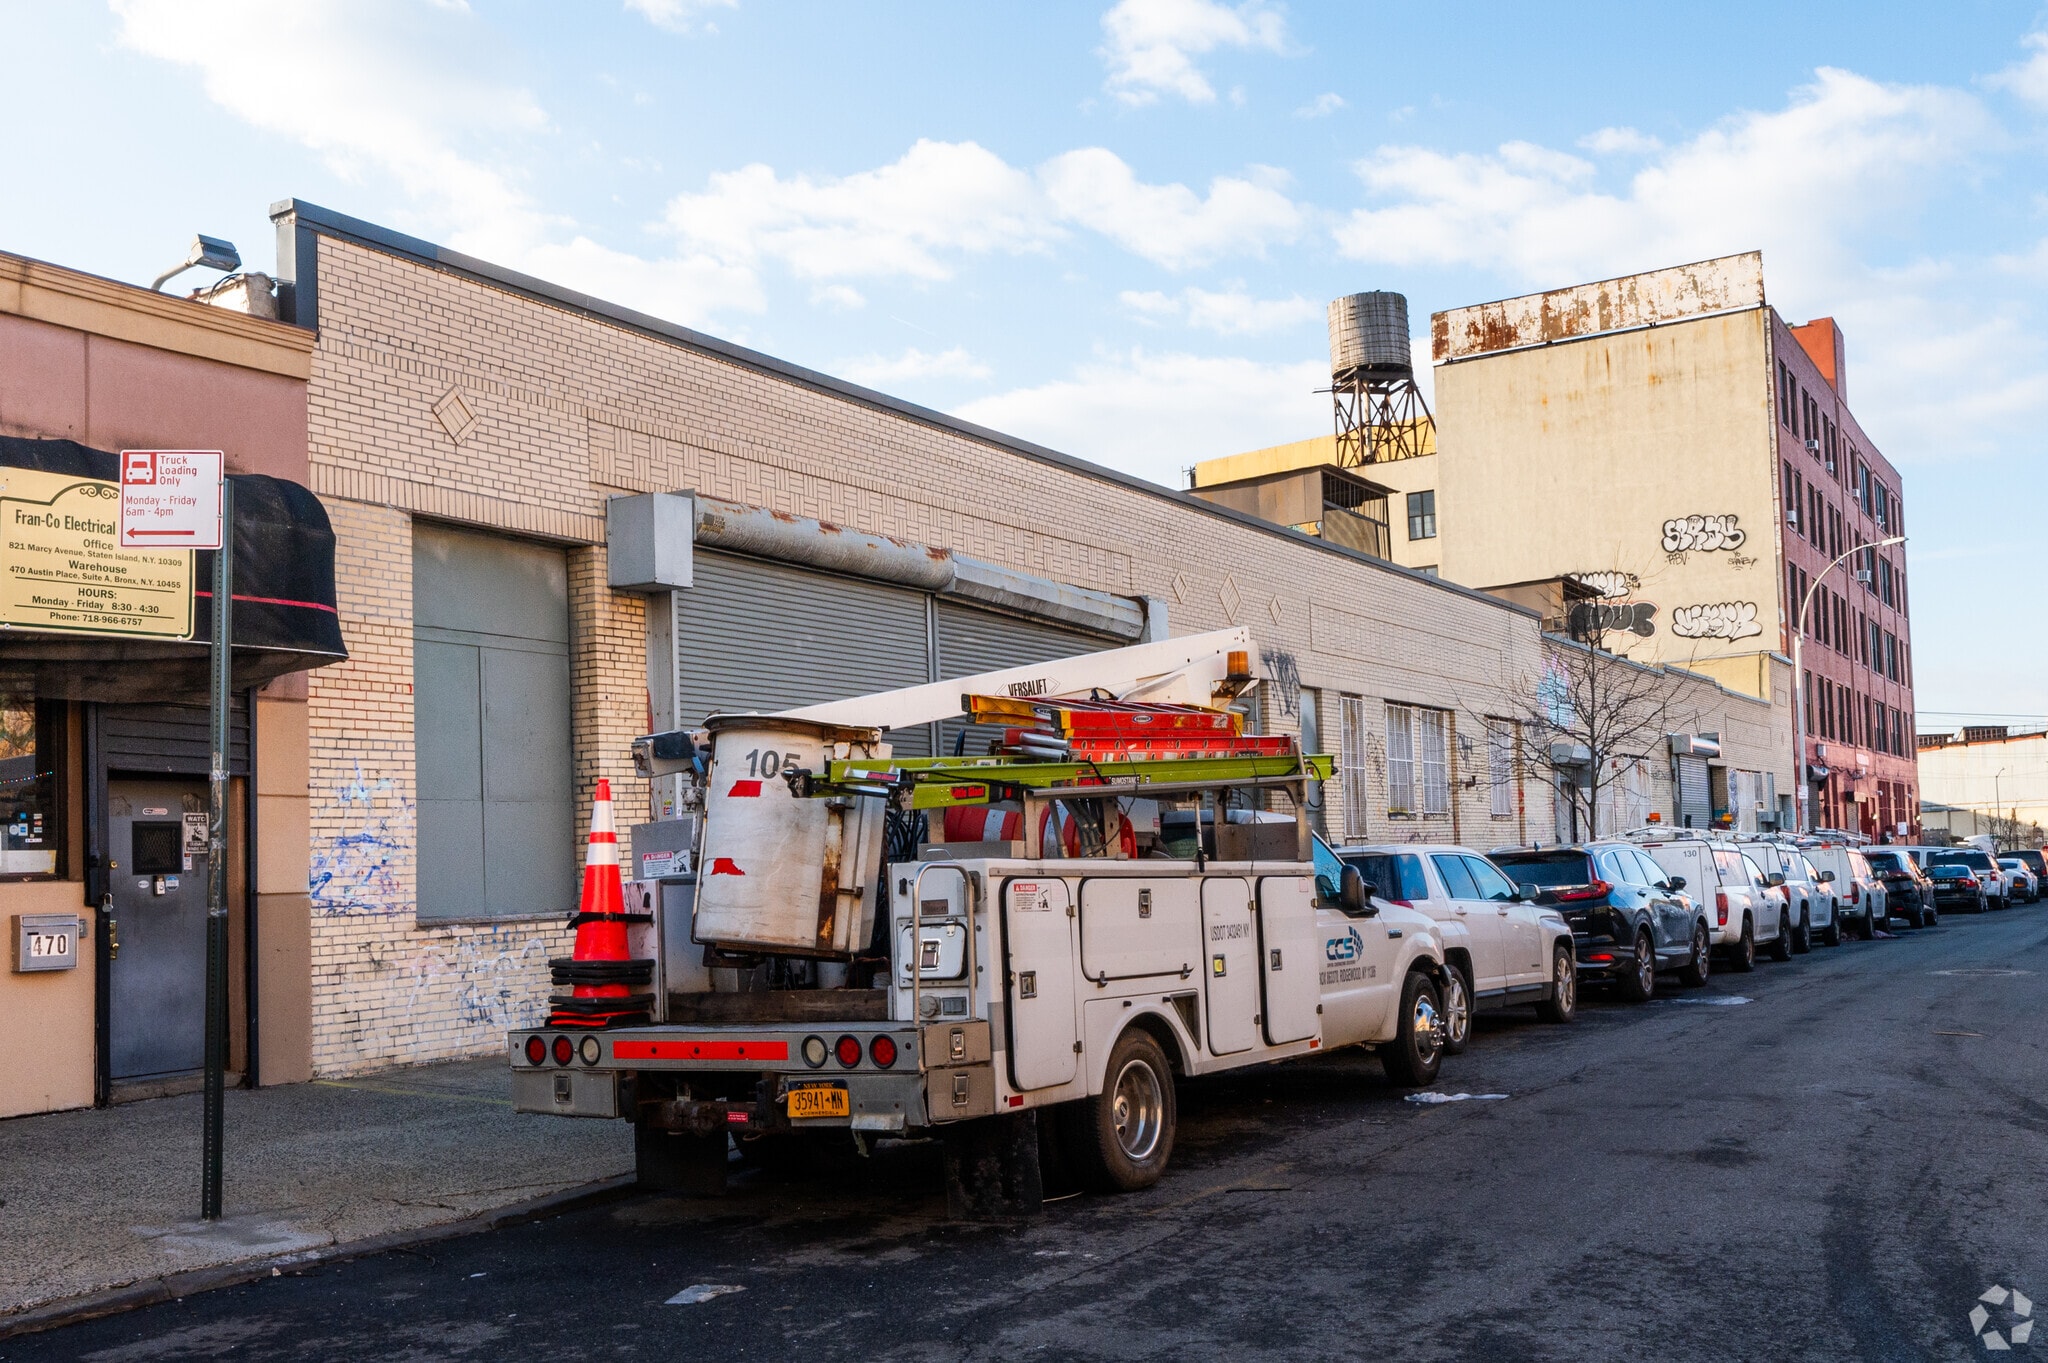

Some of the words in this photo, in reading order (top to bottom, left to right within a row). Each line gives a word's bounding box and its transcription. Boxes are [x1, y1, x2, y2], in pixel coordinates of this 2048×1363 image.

[160, 455, 188, 465] Truck
[160, 466, 198, 477] Loading
[160, 476, 181, 487] Only
[125, 495, 160, 506] Monday
[169, 495, 197, 507] Friday
[125, 507, 145, 516] 6am
[154, 507, 174, 518] 4pm
[15, 509, 60, 529] Fran-Co
[64, 515, 116, 535] Electrical
[83, 538, 114, 551] Office
[8, 541, 25, 550] 821
[27, 543, 53, 554] Marcy
[54, 546, 86, 557] Avenue,
[87, 550, 113, 559] Staten
[115, 553, 140, 563] Island,
[142, 556, 156, 564] N.Y.
[158, 558, 183, 567] 10309
[68, 559, 127, 574] Warehouse
[9, 565, 26, 574] 470
[27, 567, 54, 577] Austin
[55, 569, 81, 580] Place,
[82, 572, 102, 581] Suite
[114, 575, 139, 585] Bronx,
[140, 578, 155, 587] N.Y.
[156, 580, 181, 589] 10455
[78, 587, 117, 599] HOURS:
[31, 595, 69, 608] Monday
[76, 599, 104, 610] Friday
[111, 602, 132, 611] 8:30
[139, 604, 160, 613] 4:30
[49, 611, 80, 621] Phone:
[82, 614, 143, 626] 718-966-6757
[1008, 678, 1047, 697] VERSALIFT
[745, 748, 801, 779] 105
[1683, 849, 1697, 858] 130
[33, 935, 66, 955] 470
[1325, 937, 1354, 961] CCS
